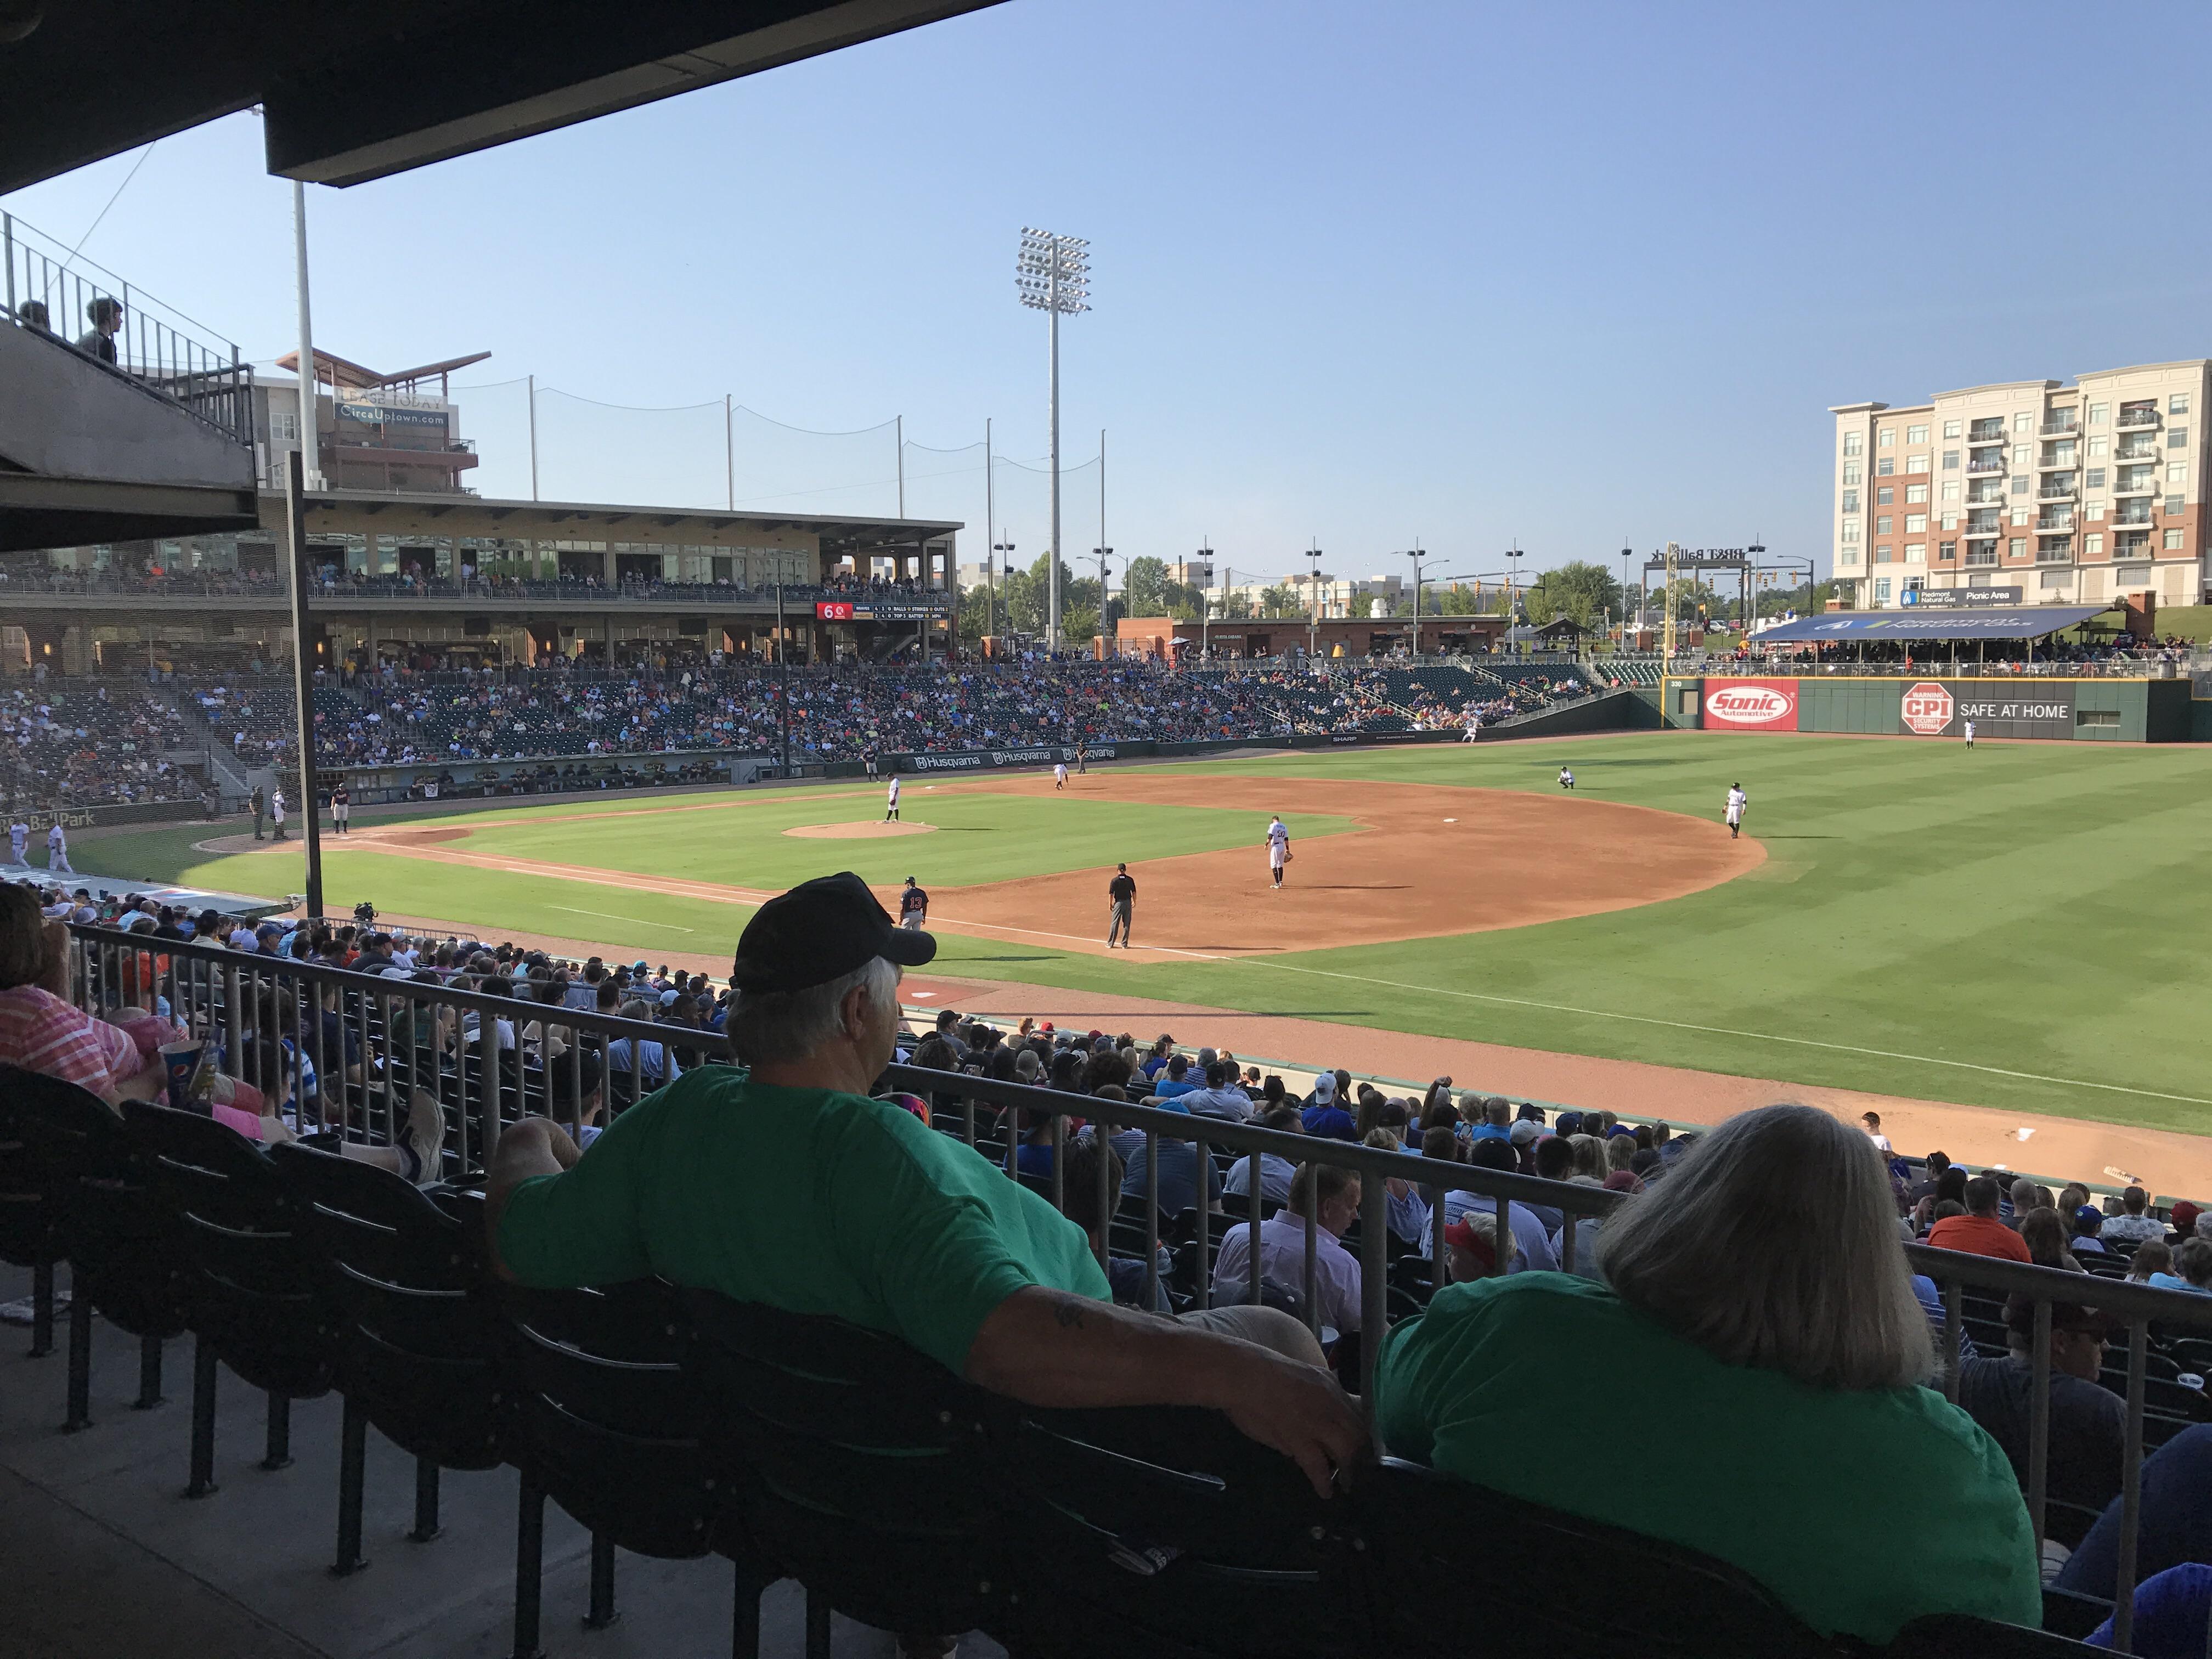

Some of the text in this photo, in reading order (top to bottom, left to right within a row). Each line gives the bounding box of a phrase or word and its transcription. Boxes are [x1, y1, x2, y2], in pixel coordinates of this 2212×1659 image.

[340, 388, 442, 409] LEASE TODAY
[341, 405, 444, 425] CircaUptown.com
[1966, 591, 2010, 600] Picnic Area
[825, 605, 833, 619] 6
[1713, 693, 1781, 710] Sonic
[1905, 699, 1951, 716] CPI
[1960, 703, 2068, 719] SAFE AT HOME
[1003, 751, 1051, 762] Husqvarna
[1071, 749, 1115, 760] Hqvarna
[926, 757, 981, 768] Husqvarna
[910, 896, 922, 909] 13
